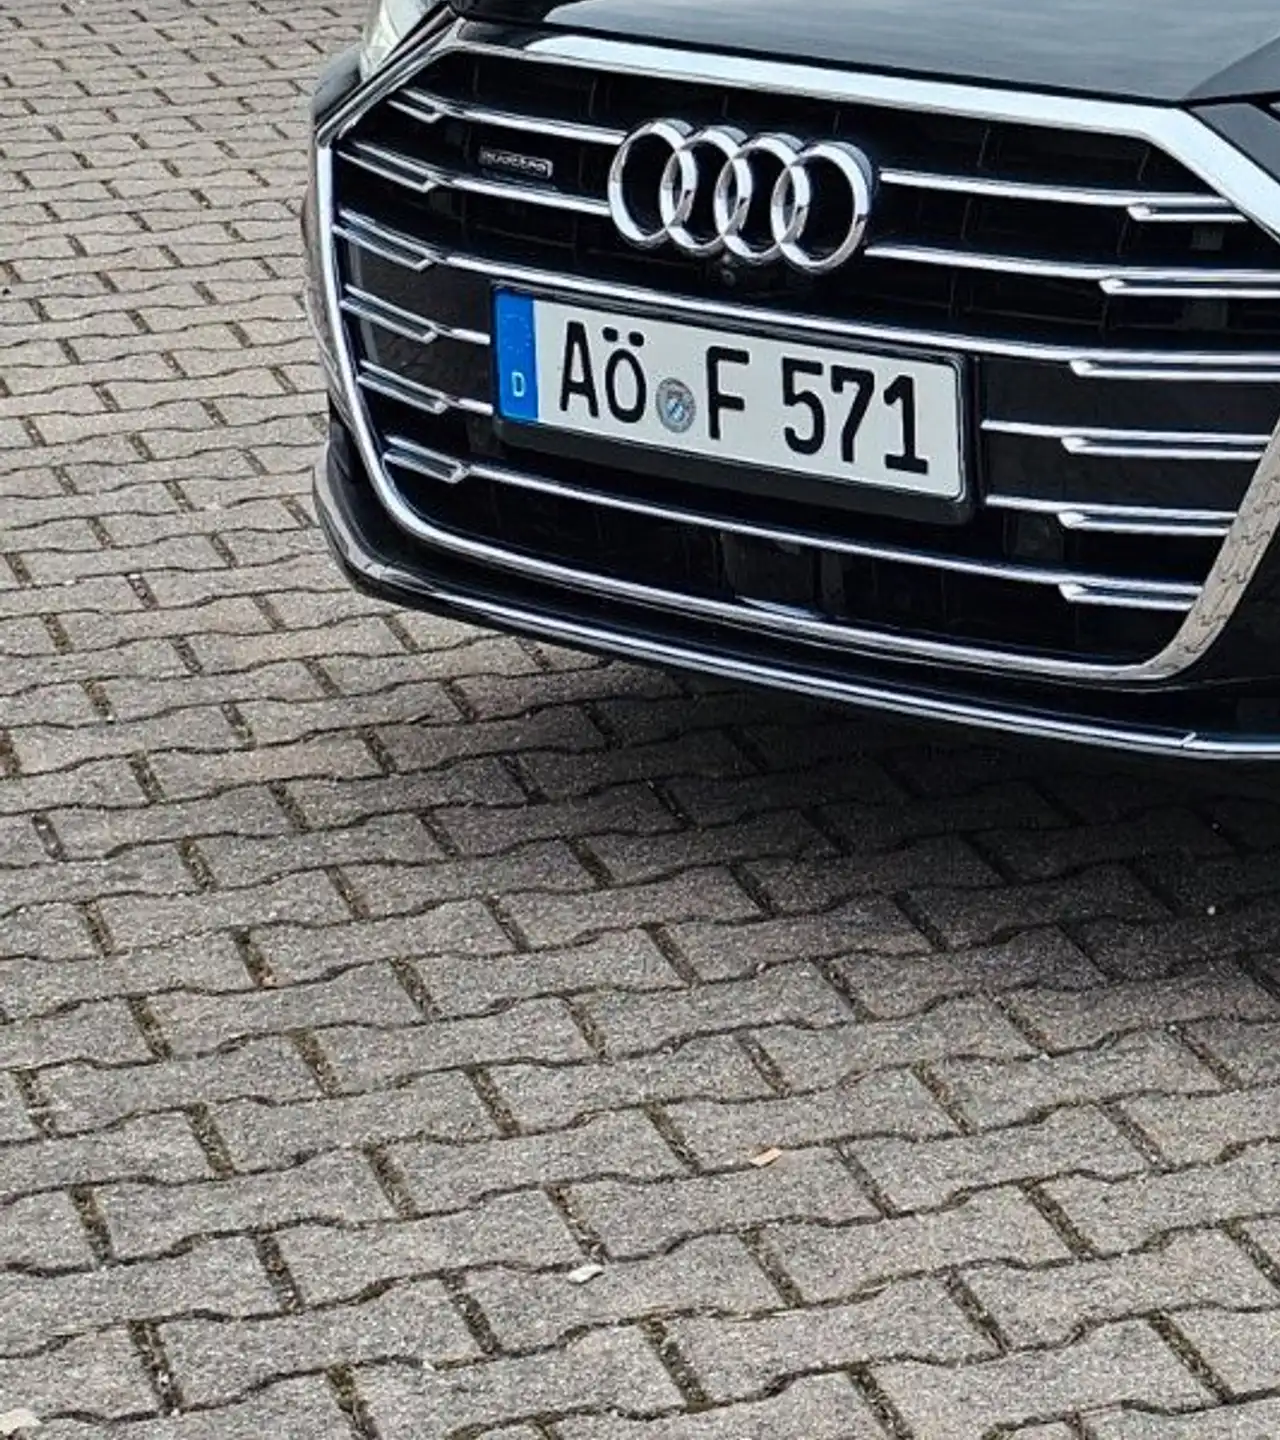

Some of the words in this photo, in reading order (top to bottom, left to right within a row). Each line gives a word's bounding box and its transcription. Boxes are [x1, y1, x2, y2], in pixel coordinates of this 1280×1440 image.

[511, 372, 525, 398] D
[559, 320, 647, 424] AÖ
[705, 345, 751, 440] F
[781, 357, 929, 475] 571
